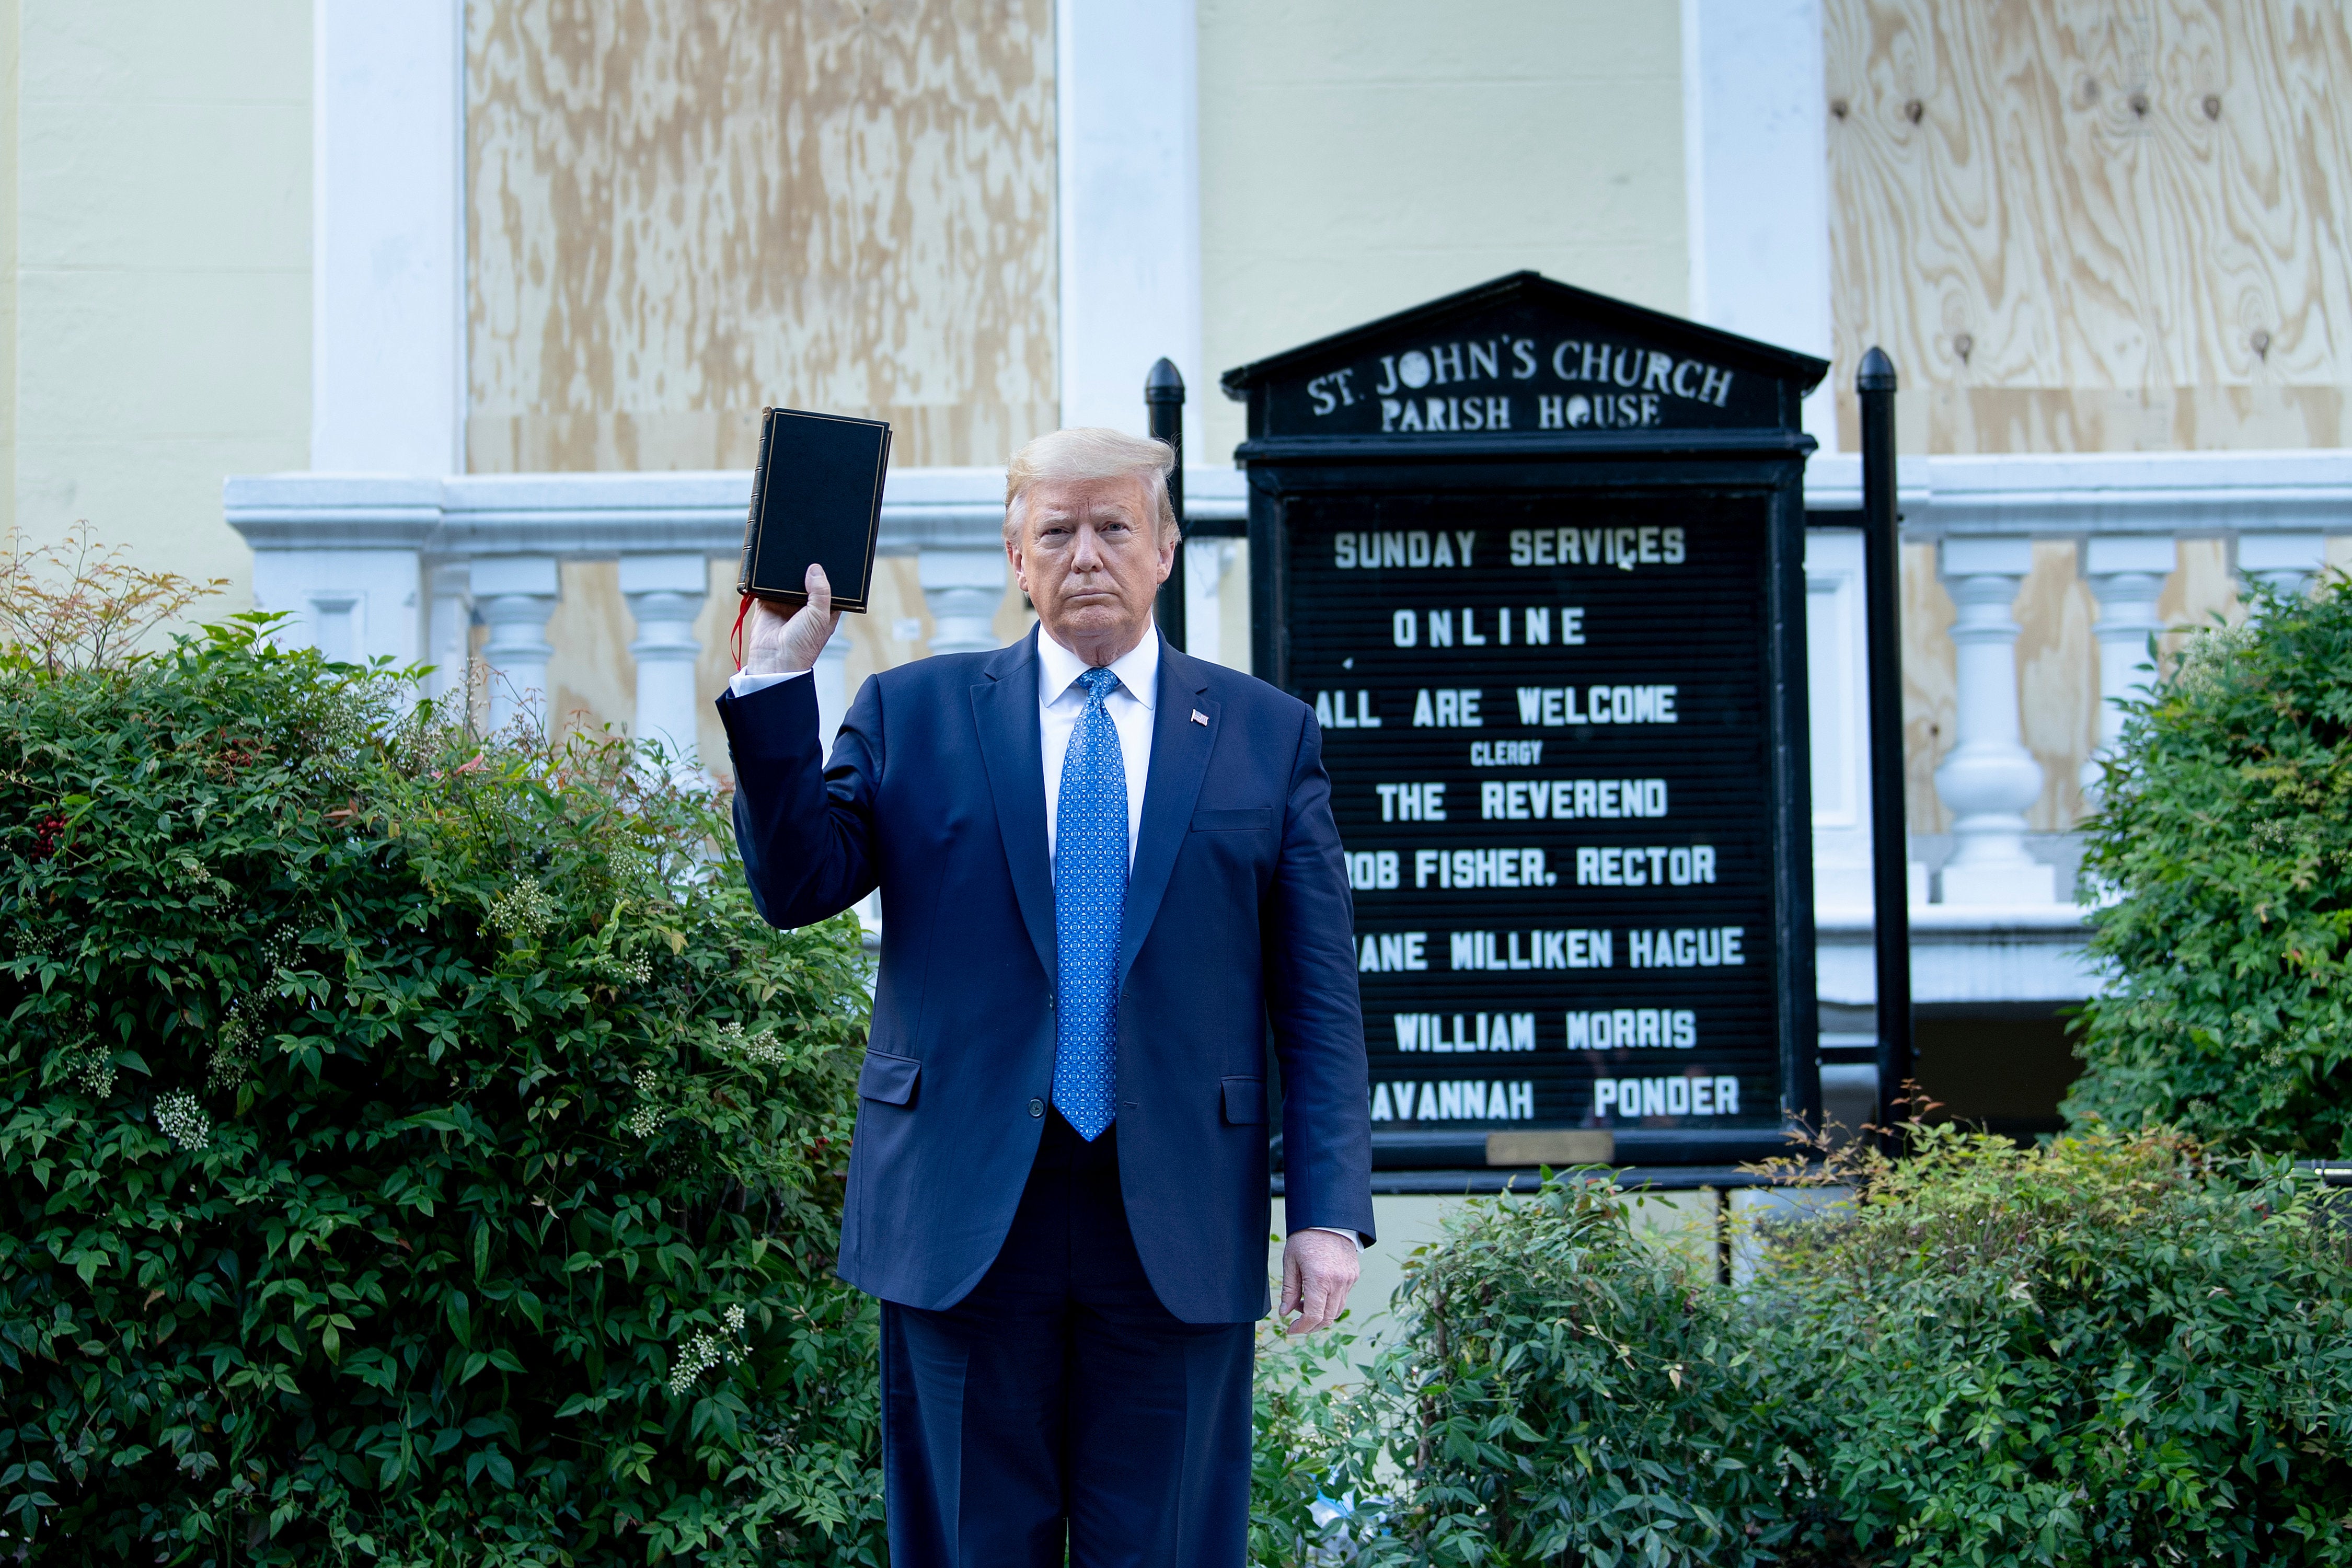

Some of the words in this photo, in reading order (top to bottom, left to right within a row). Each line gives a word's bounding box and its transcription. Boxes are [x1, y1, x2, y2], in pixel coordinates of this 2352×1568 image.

[1307, 368, 1366, 417] ST.
[1376, 334, 1537, 396] JOHN'S
[1552, 340, 1734, 408] CHURCH
[1379, 396, 1511, 433] PARISH
[1538, 394, 1662, 430] HOUSE
[1335, 532, 1474, 569] SUNDAY
[1510, 527, 1685, 566] SERVICES
[1392, 606, 1586, 648] ONLINE
[1315, 689, 1382, 729] ALL
[1412, 688, 1483, 728] ARE
[1516, 684, 1678, 727] WELCOME
[1470, 740, 1543, 767] CLERGY
[1375, 782, 1447, 822] THE
[1480, 778, 1668, 820] REVEREND
[1576, 844, 1716, 887] RECTOR
[1449, 928, 1613, 971] MILLIKEN
[1628, 926, 1746, 969] HAGUE
[1393, 1011, 1536, 1053] WILLIAM
[1565, 1008, 1697, 1051] MORRIS
[1368, 1079, 1535, 1122] AVANNAH
[1593, 1075, 1740, 1119] PONDER
